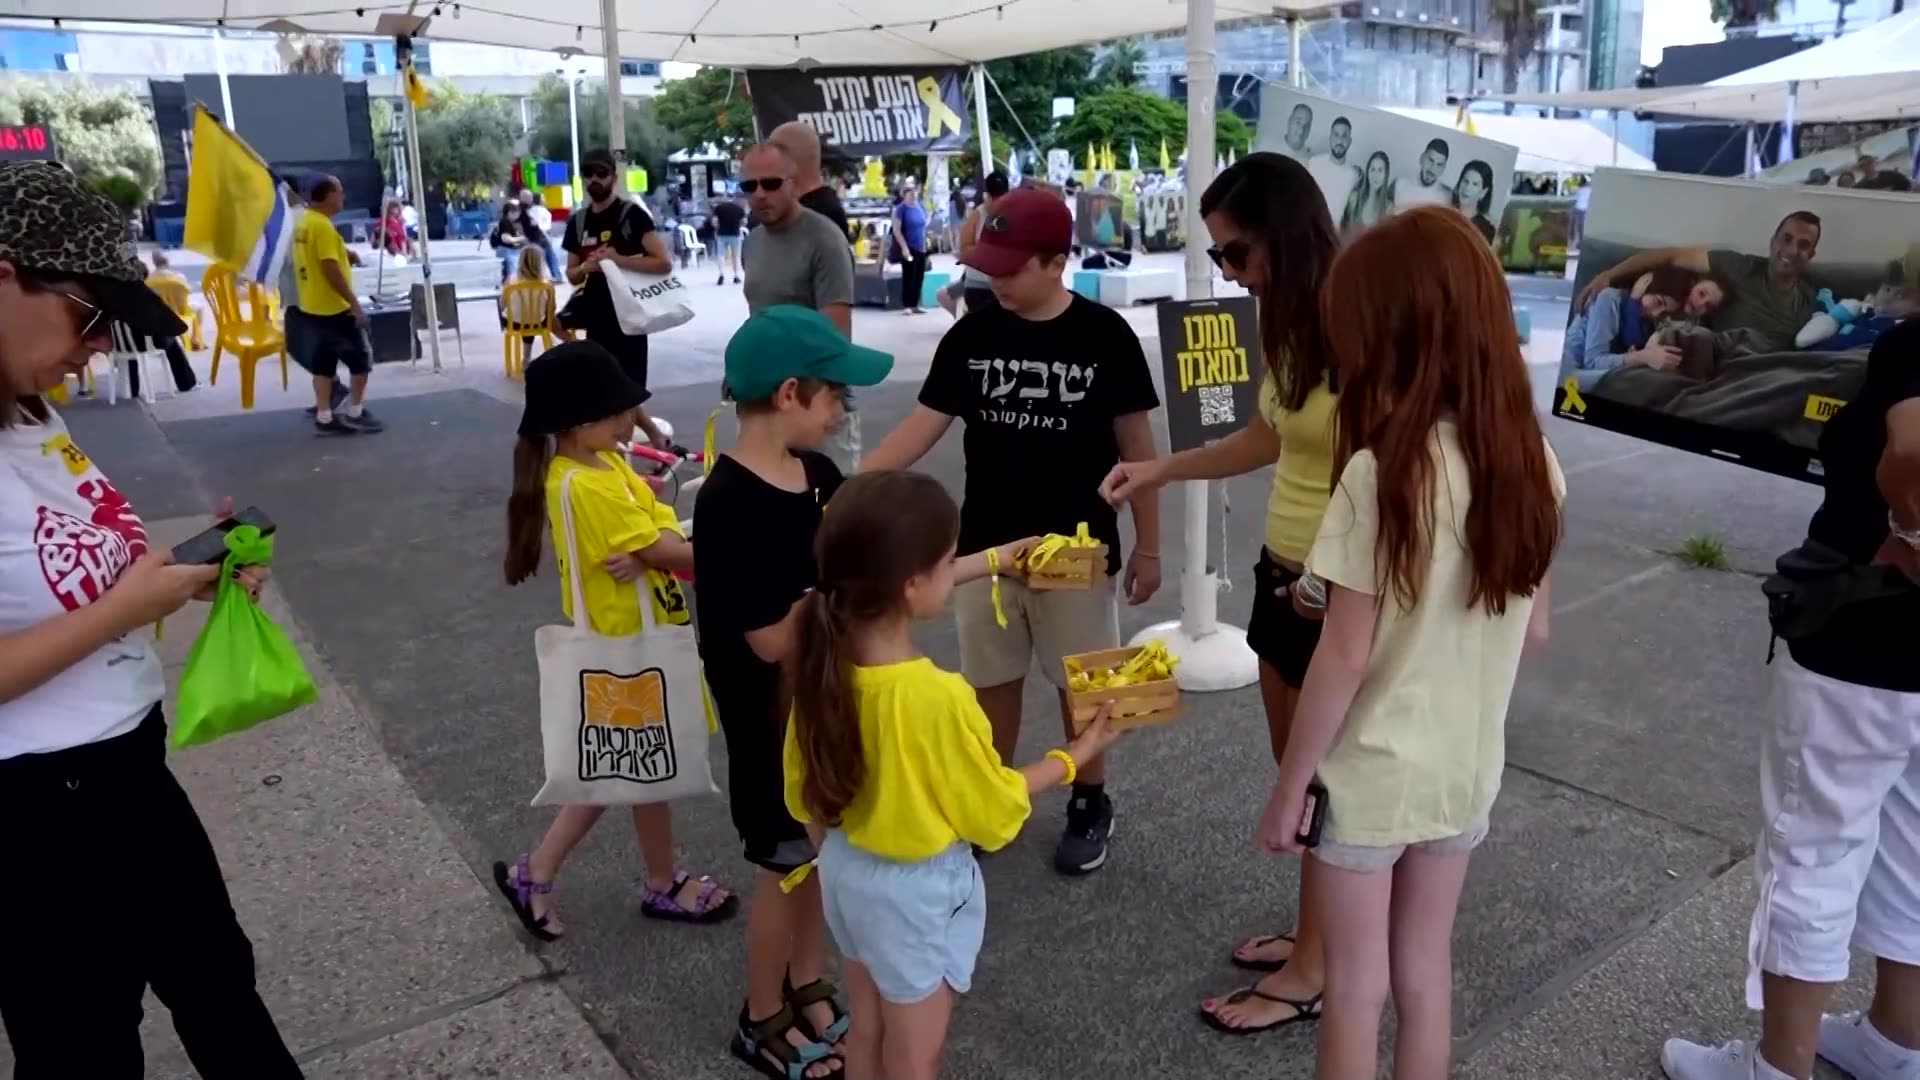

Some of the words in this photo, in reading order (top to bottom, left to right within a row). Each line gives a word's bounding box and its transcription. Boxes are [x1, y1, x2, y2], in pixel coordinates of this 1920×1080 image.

[814, 75, 871, 110] יחזיר
[872, 76, 919, 108] העם
[894, 107, 926, 140] את
[1183, 312, 1237, 350] תמכו
[1177, 347, 1250, 393] במאבק
[979, 409, 1068, 430] באוקטובר
